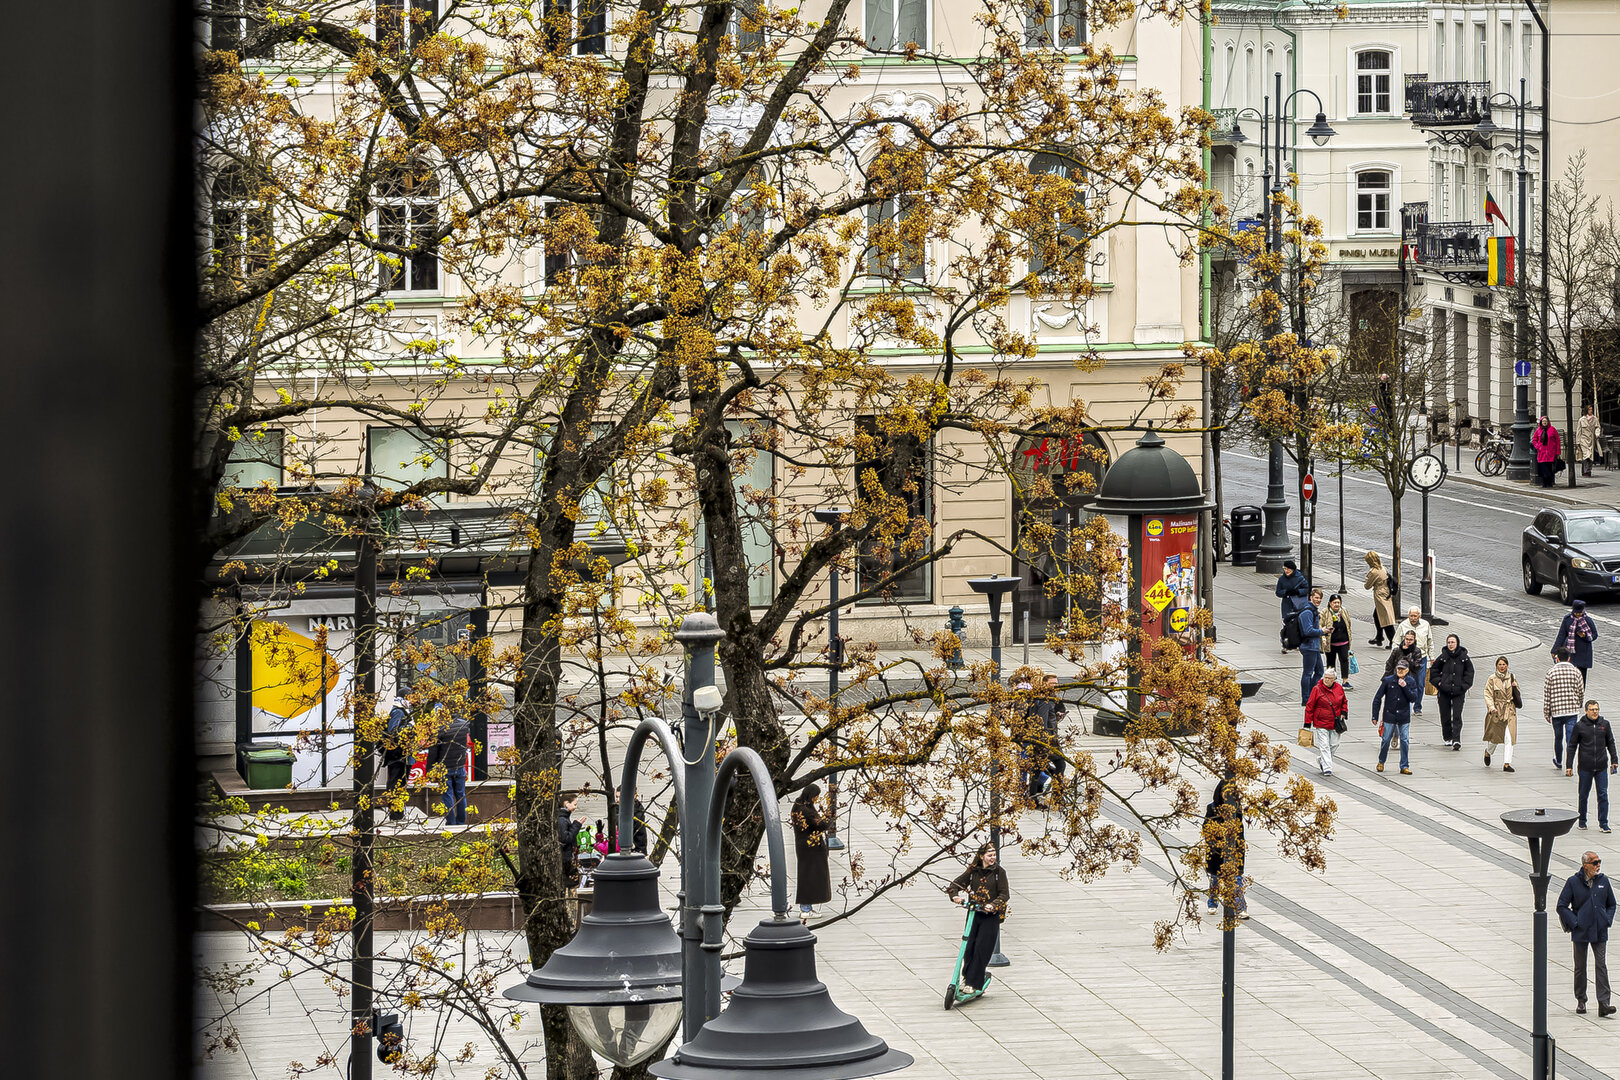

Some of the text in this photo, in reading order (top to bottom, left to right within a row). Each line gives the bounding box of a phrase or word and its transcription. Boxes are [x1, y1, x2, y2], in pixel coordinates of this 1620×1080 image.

[1369, 248, 1400, 257] MUZIEJ
[1145, 588, 1172, 600] -44€
[308, 614, 416, 632] NARSEN
